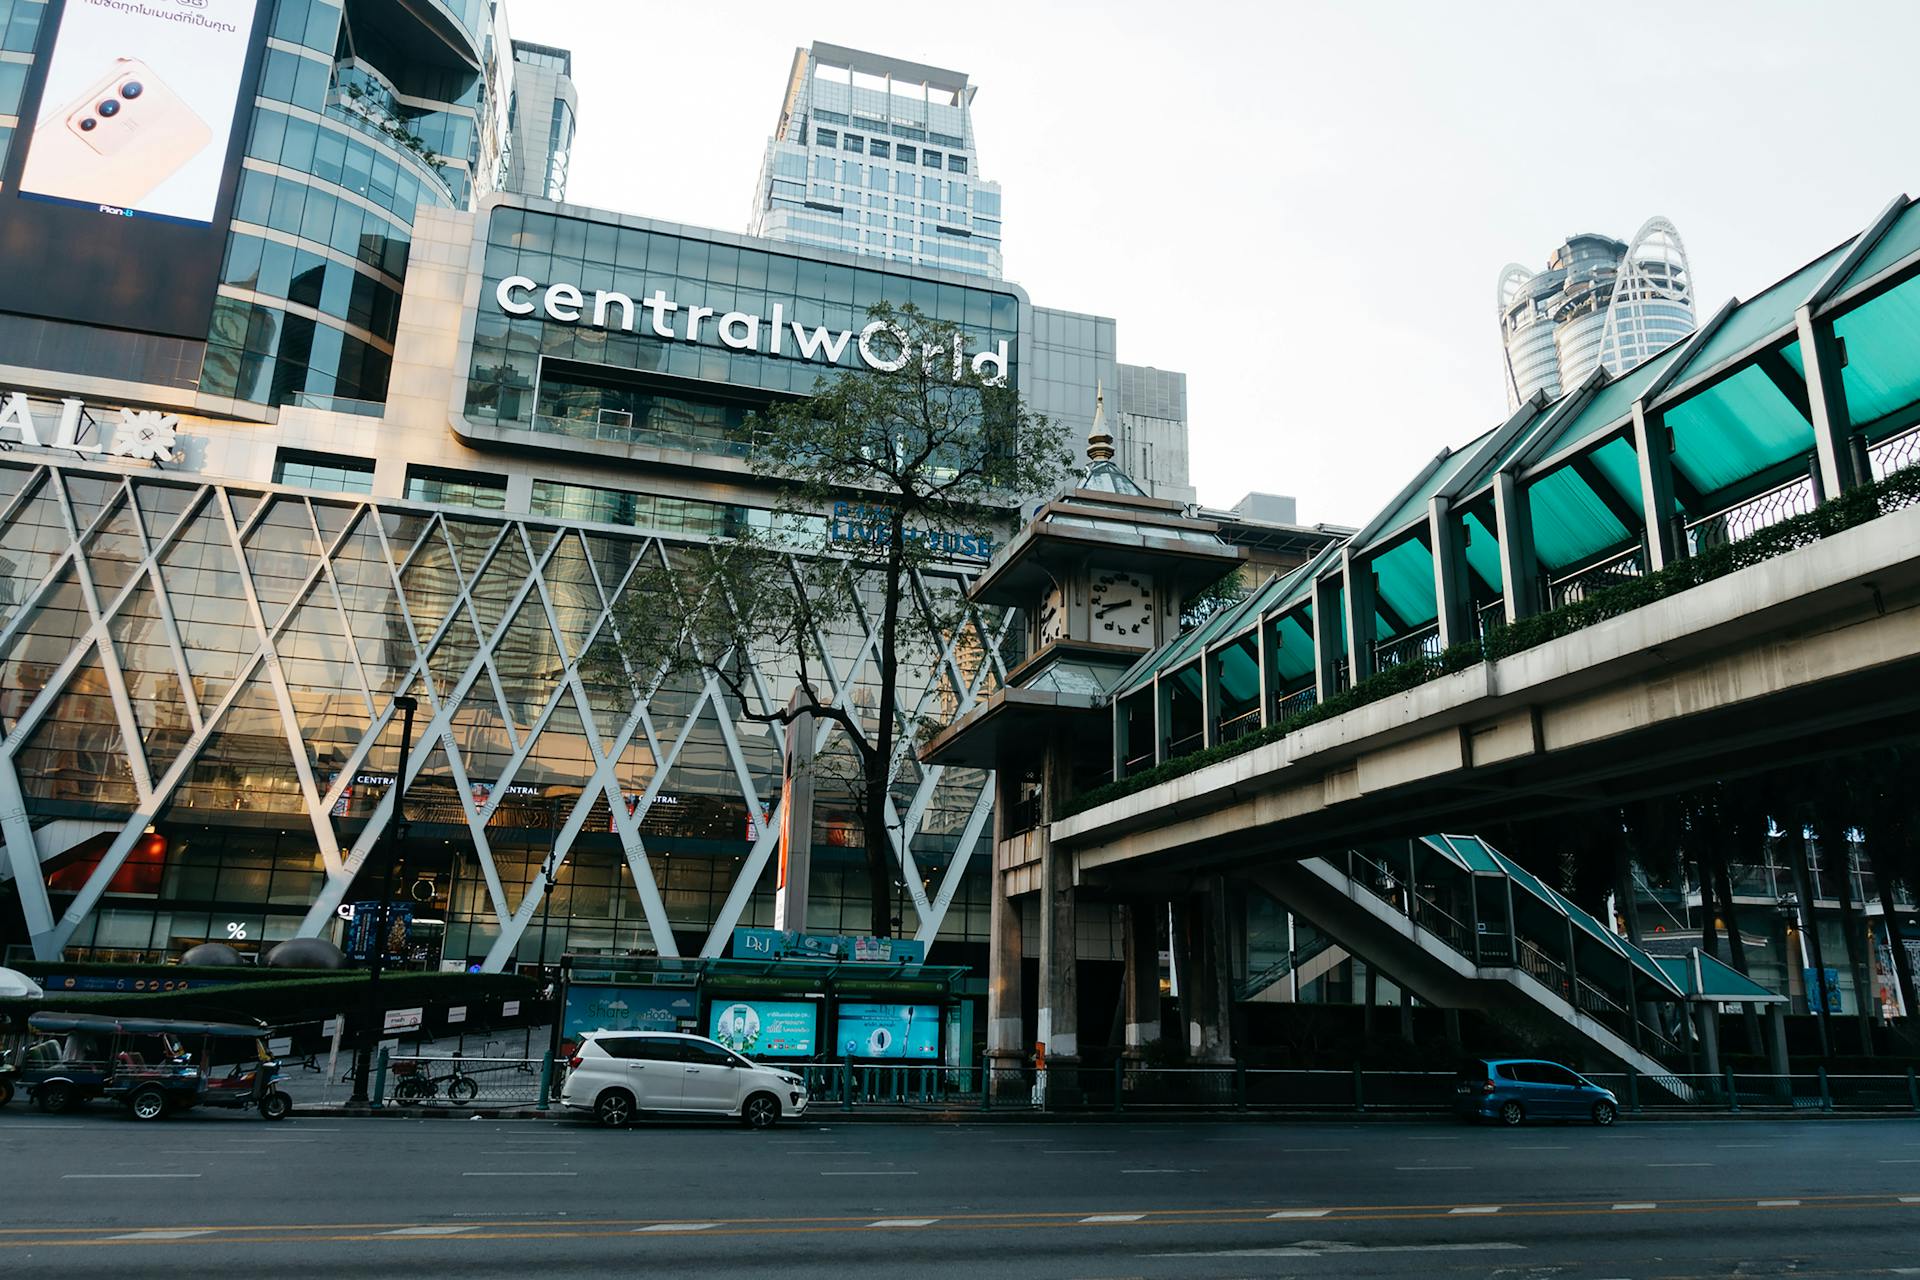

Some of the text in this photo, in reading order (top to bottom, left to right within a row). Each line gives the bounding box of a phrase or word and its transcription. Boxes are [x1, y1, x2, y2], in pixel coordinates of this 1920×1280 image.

[0, 392, 103, 454] AL
[357, 775, 396, 786] CENTRA
[505, 786, 540, 796] ENTRAL
[587, 1002, 630, 1019] Share
